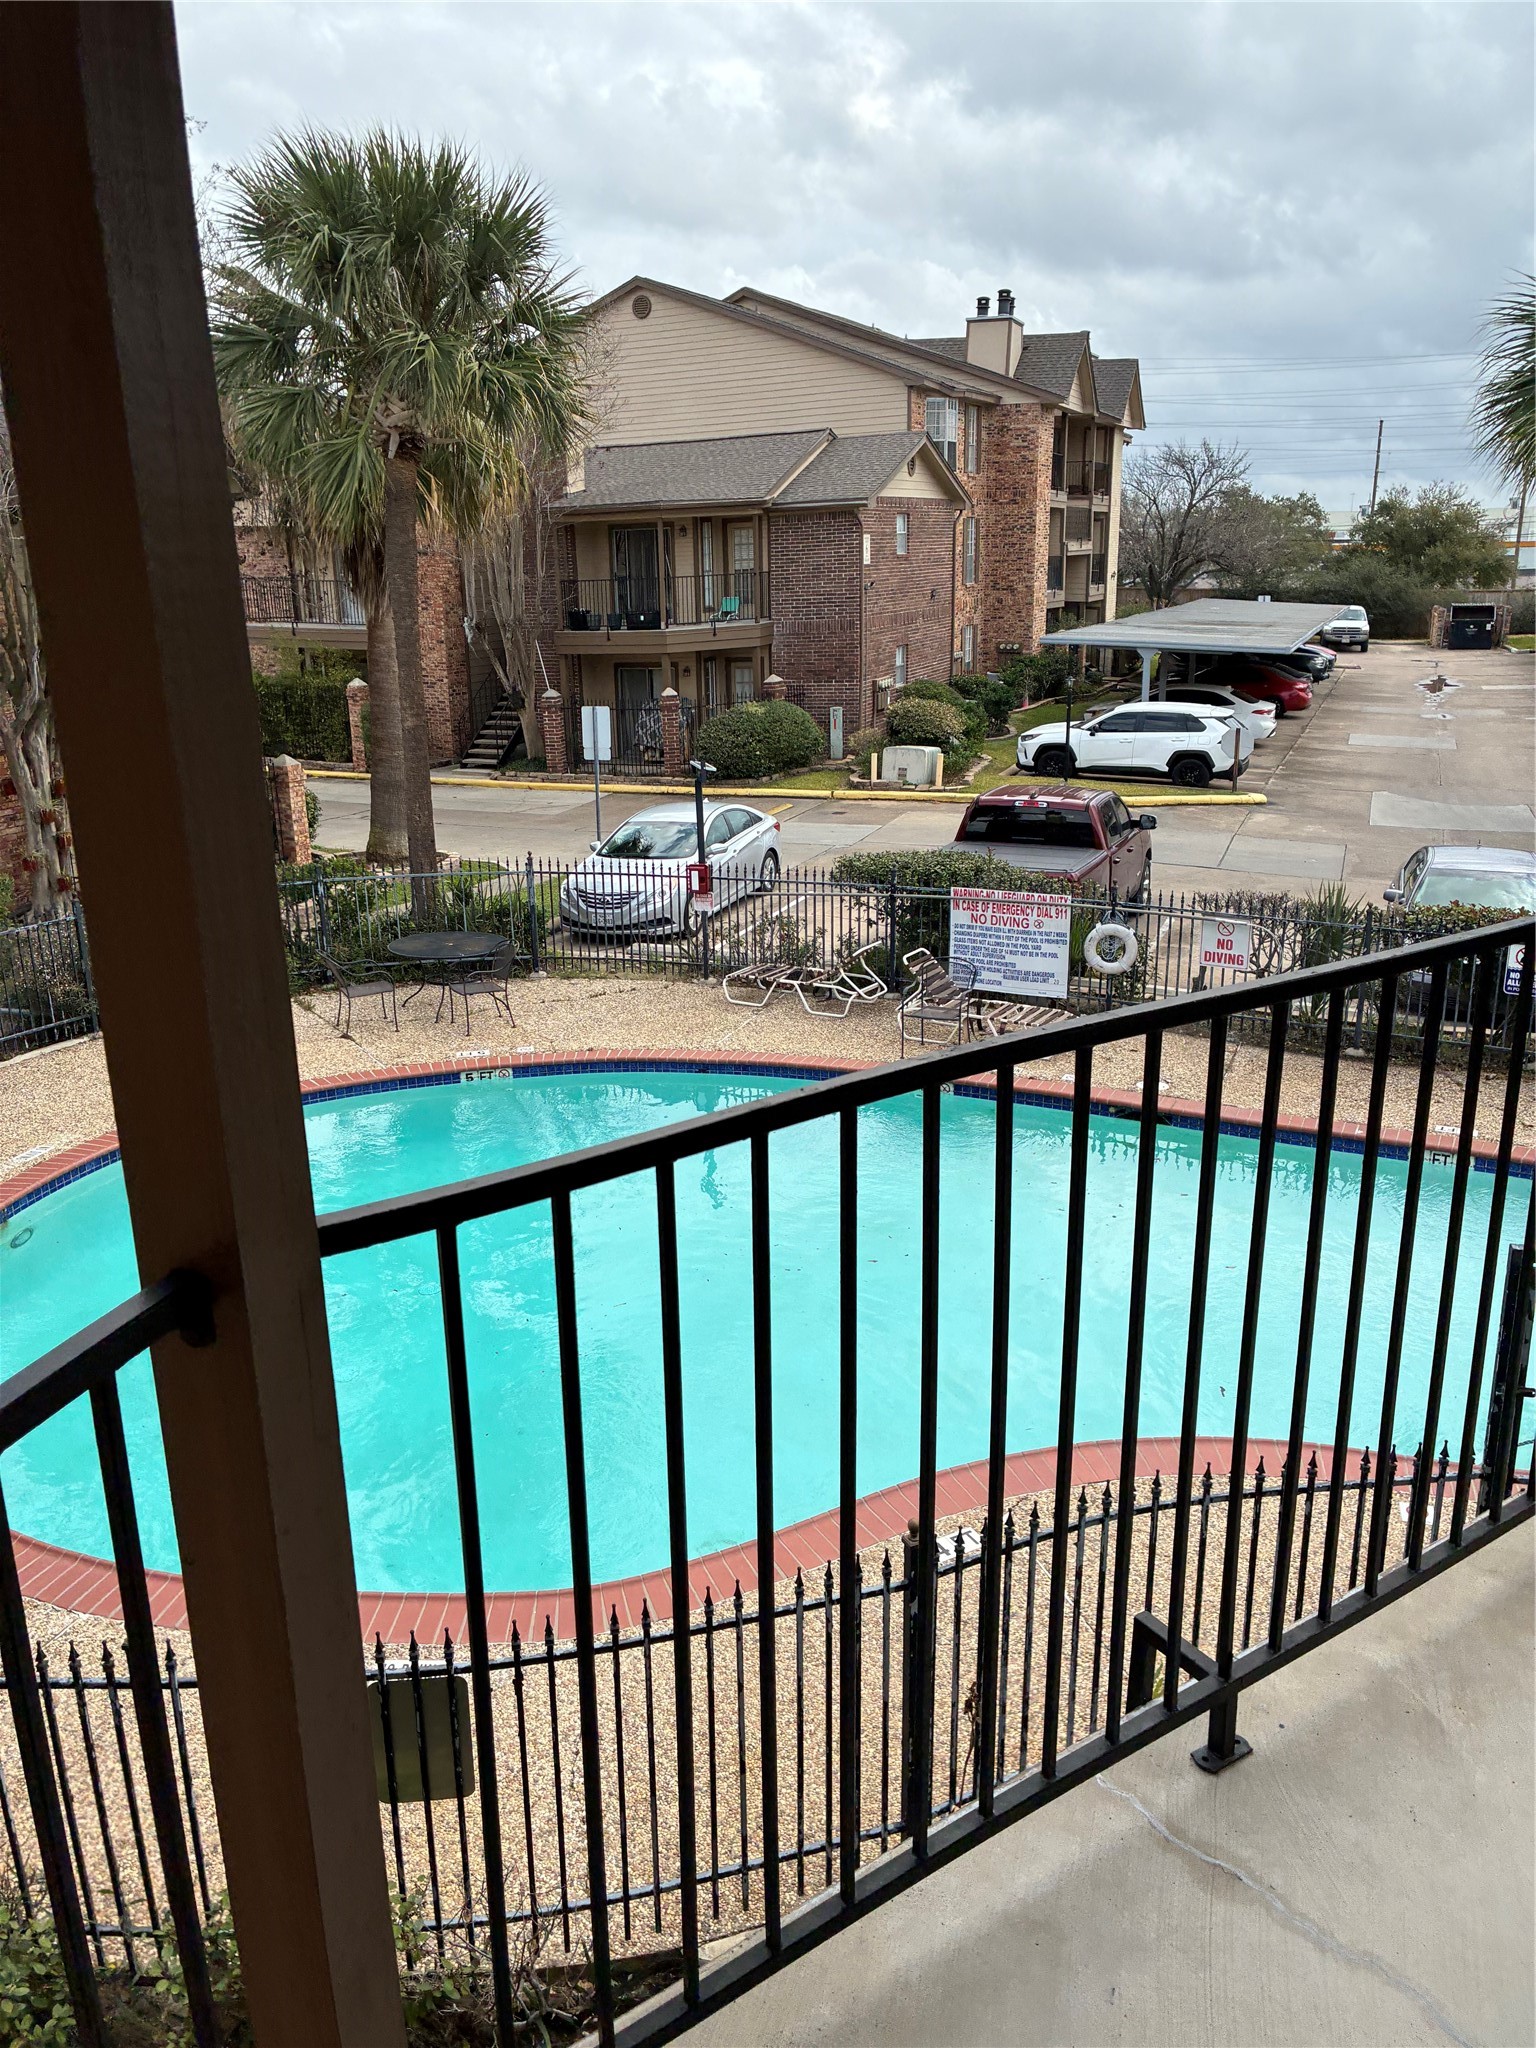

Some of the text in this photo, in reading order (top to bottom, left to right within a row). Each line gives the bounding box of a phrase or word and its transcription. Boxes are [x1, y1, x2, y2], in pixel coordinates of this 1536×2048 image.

[953, 900, 1068, 920] IN CASE OF EMERGENCY DIAL 911
[970, 912, 1030, 928] NO DIVING
[1216, 938, 1234, 951] NO
[1204, 950, 1244, 966] DIVING
[465, 1071, 494, 1082] 5 FT
[1432, 1152, 1450, 1166] FT
